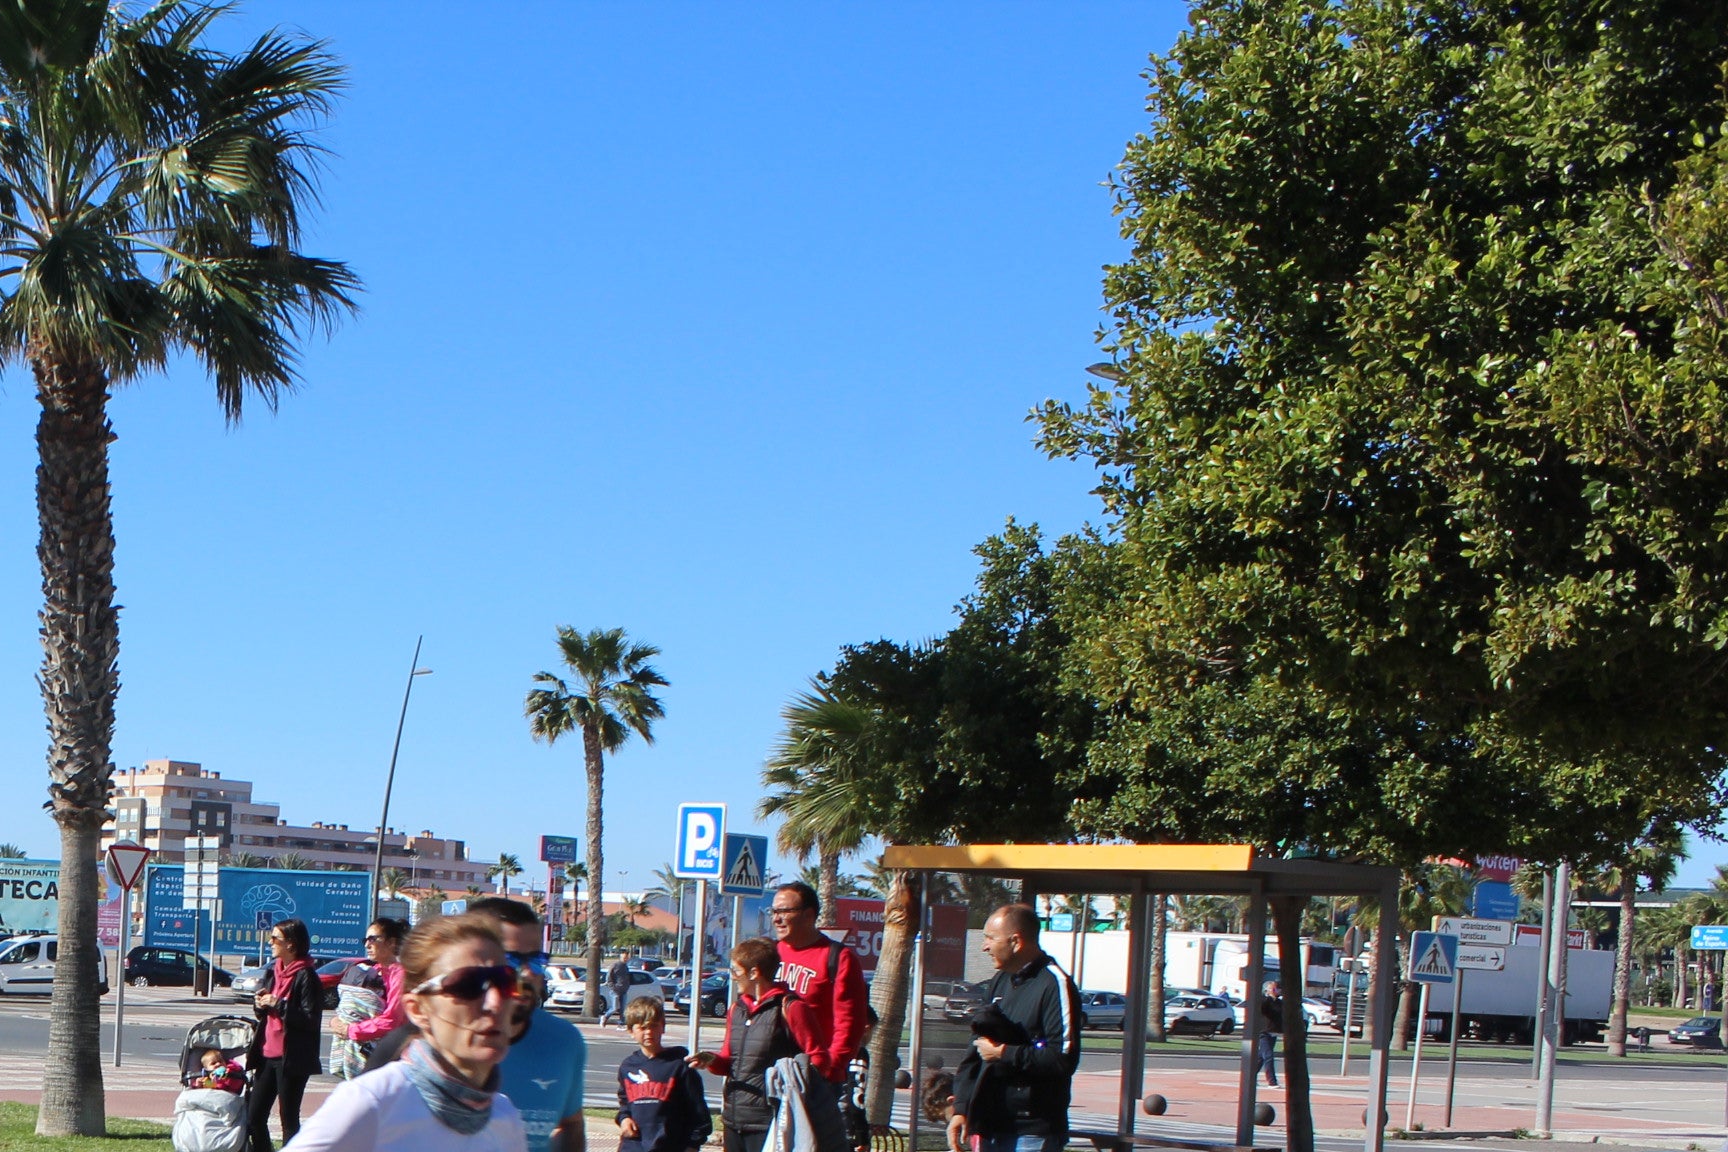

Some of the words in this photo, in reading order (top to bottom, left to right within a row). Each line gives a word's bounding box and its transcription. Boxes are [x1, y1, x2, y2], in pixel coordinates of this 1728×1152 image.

[684, 812, 716, 868] P
[22, 868, 61, 878] INFANTI
[296, 880, 325, 888] Unidad
[327, 881, 338, 889] de
[341, 881, 362, 889] Daño
[325, 888, 362, 896] Cerebral
[331, 910, 360, 918] Tumores
[850, 910, 886, 924] FINANC
[312, 918, 360, 926] Traumatismos
[1460, 922, 1502, 932] urbanizaciones
[106, 927, 120, 937] 58
[773, 961, 817, 995] ANT
